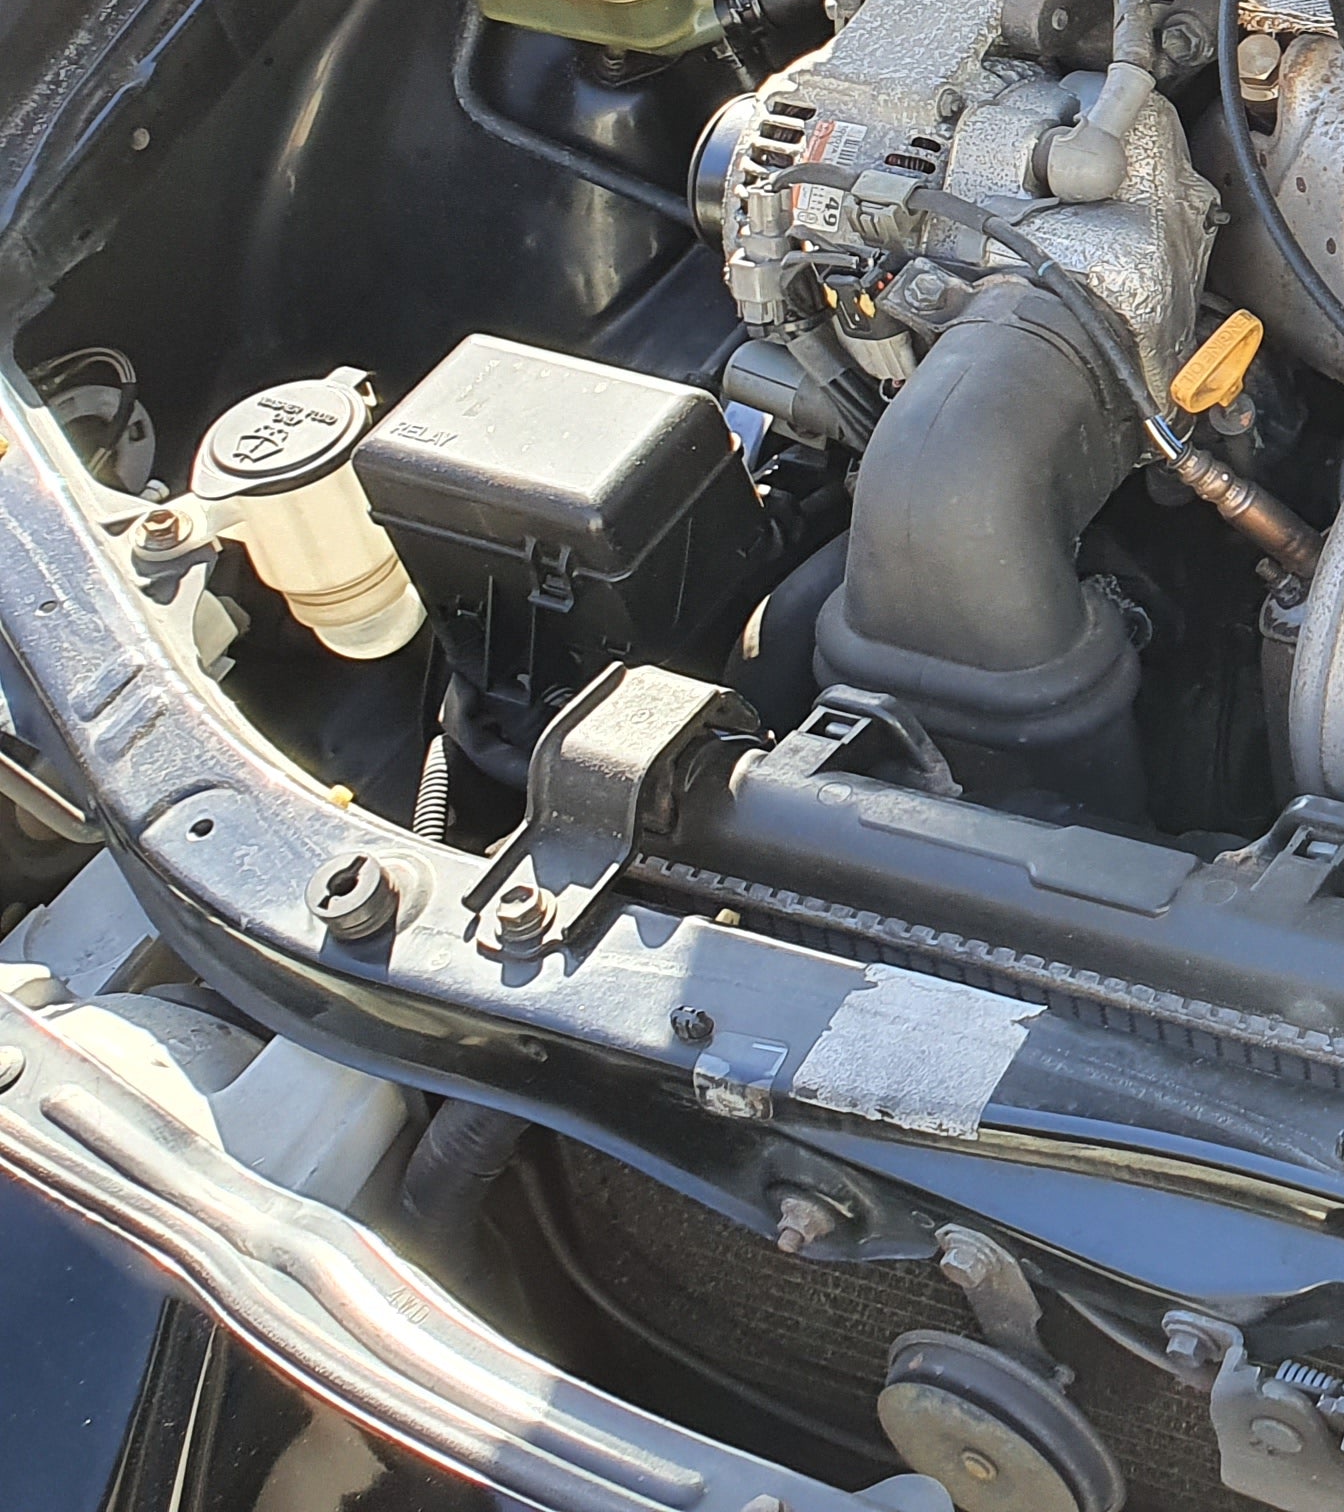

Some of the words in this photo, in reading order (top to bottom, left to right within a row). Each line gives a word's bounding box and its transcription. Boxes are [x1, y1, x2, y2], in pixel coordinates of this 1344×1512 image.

[822, 196, 840, 227] 49
[388, 421, 459, 448] RELAY
[384, 1287, 431, 1324] 4WD
